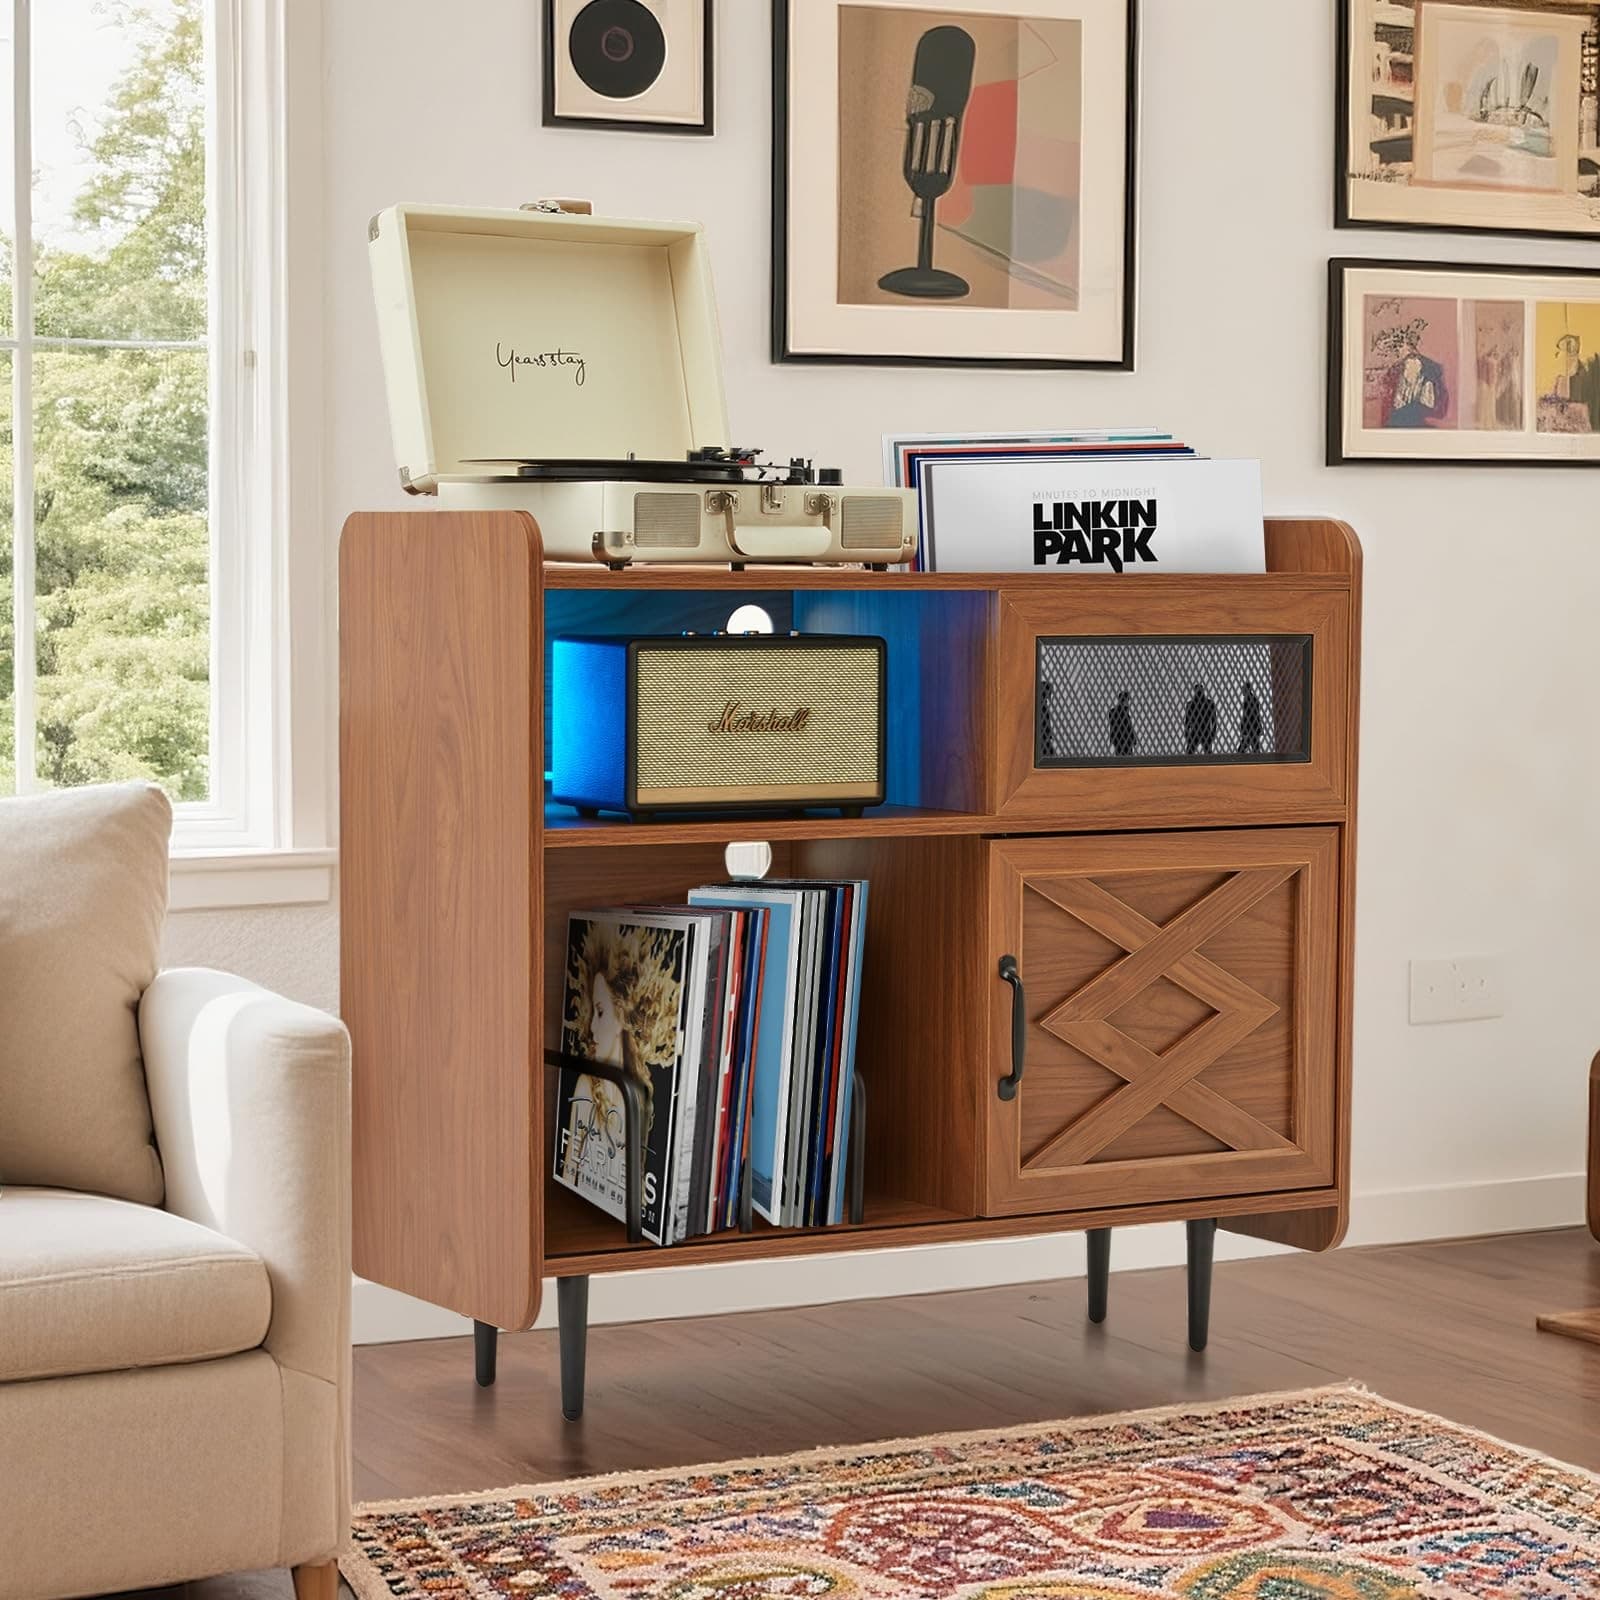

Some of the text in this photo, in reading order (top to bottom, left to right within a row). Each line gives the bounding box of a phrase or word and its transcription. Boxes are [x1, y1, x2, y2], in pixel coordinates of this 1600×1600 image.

[1032, 487, 1157, 500] MINUTES TO MIDNIGHT
[1033, 499, 1157, 542] LINKIN
[1034, 527, 1159, 573] PARK
[709, 701, 810, 733] Marshall
